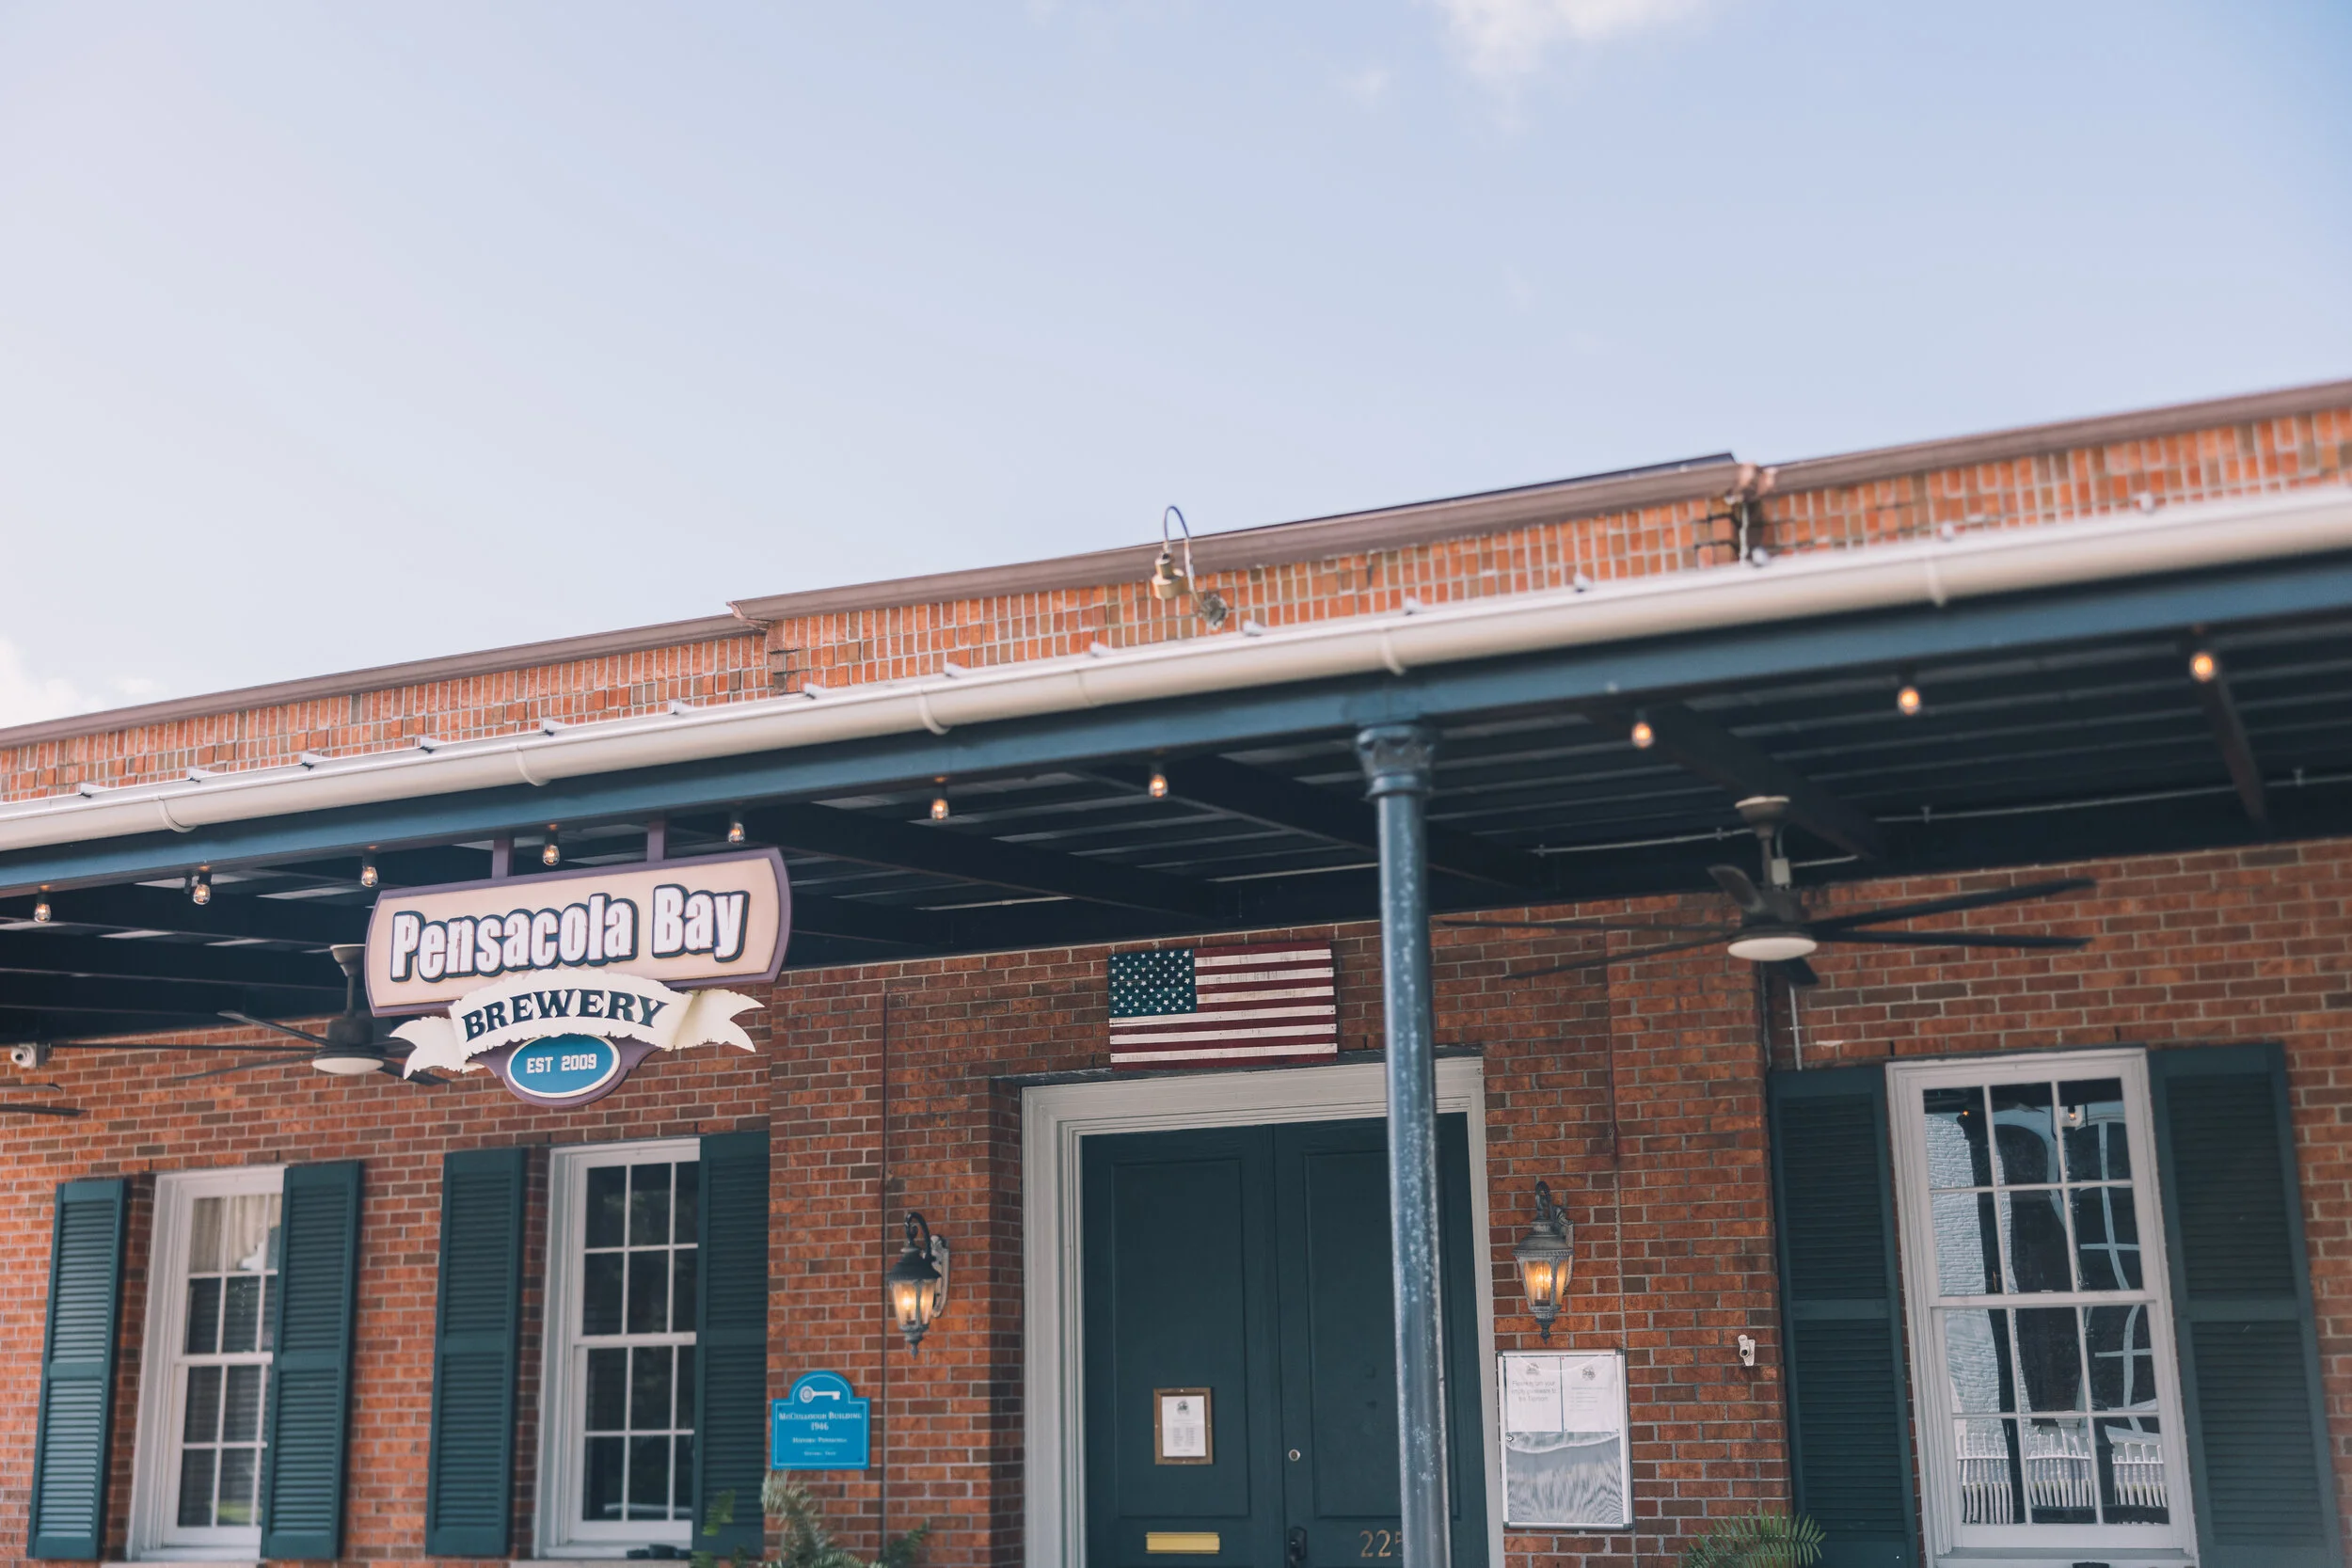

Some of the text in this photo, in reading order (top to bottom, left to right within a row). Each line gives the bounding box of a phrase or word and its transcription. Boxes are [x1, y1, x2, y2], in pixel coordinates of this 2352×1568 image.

[390, 884, 750, 982] Pensacola Bay
[461, 989, 669, 1041] BREWERY
[526, 1053, 597, 1074] EST 2009
